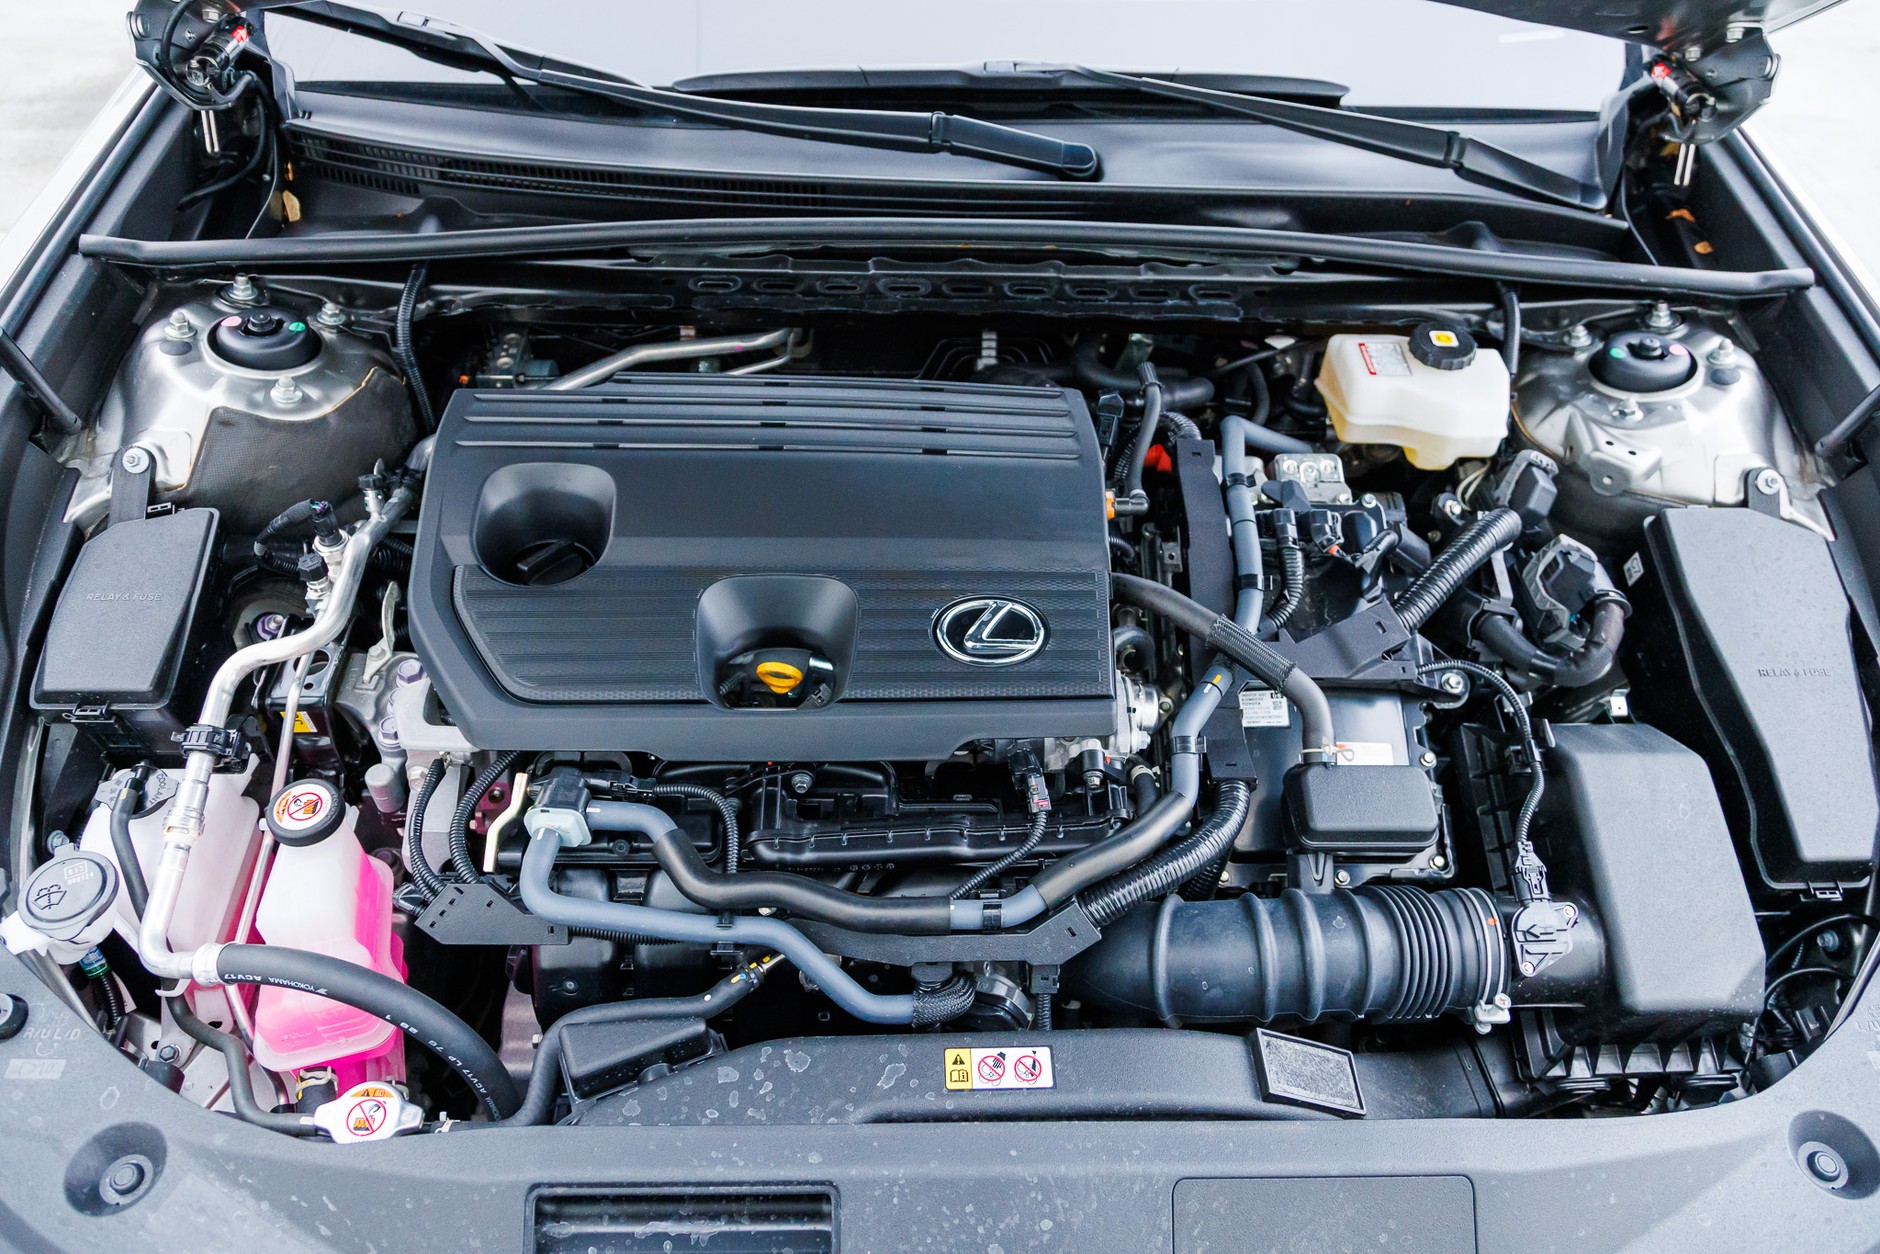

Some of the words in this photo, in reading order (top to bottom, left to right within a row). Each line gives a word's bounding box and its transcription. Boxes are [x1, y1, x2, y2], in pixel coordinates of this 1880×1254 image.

[85, 592, 122, 601] RELAY
[133, 592, 162, 601] FUSE
[1757, 668, 1791, 677] RELAY
[1802, 668, 1832, 677] FUSE
[224, 973, 262, 981] ACV17
[267, 976, 315, 992] YOKOHAMA
[448, 1055, 463, 1067] LP
[462, 1068, 487, 1094] ACV17
